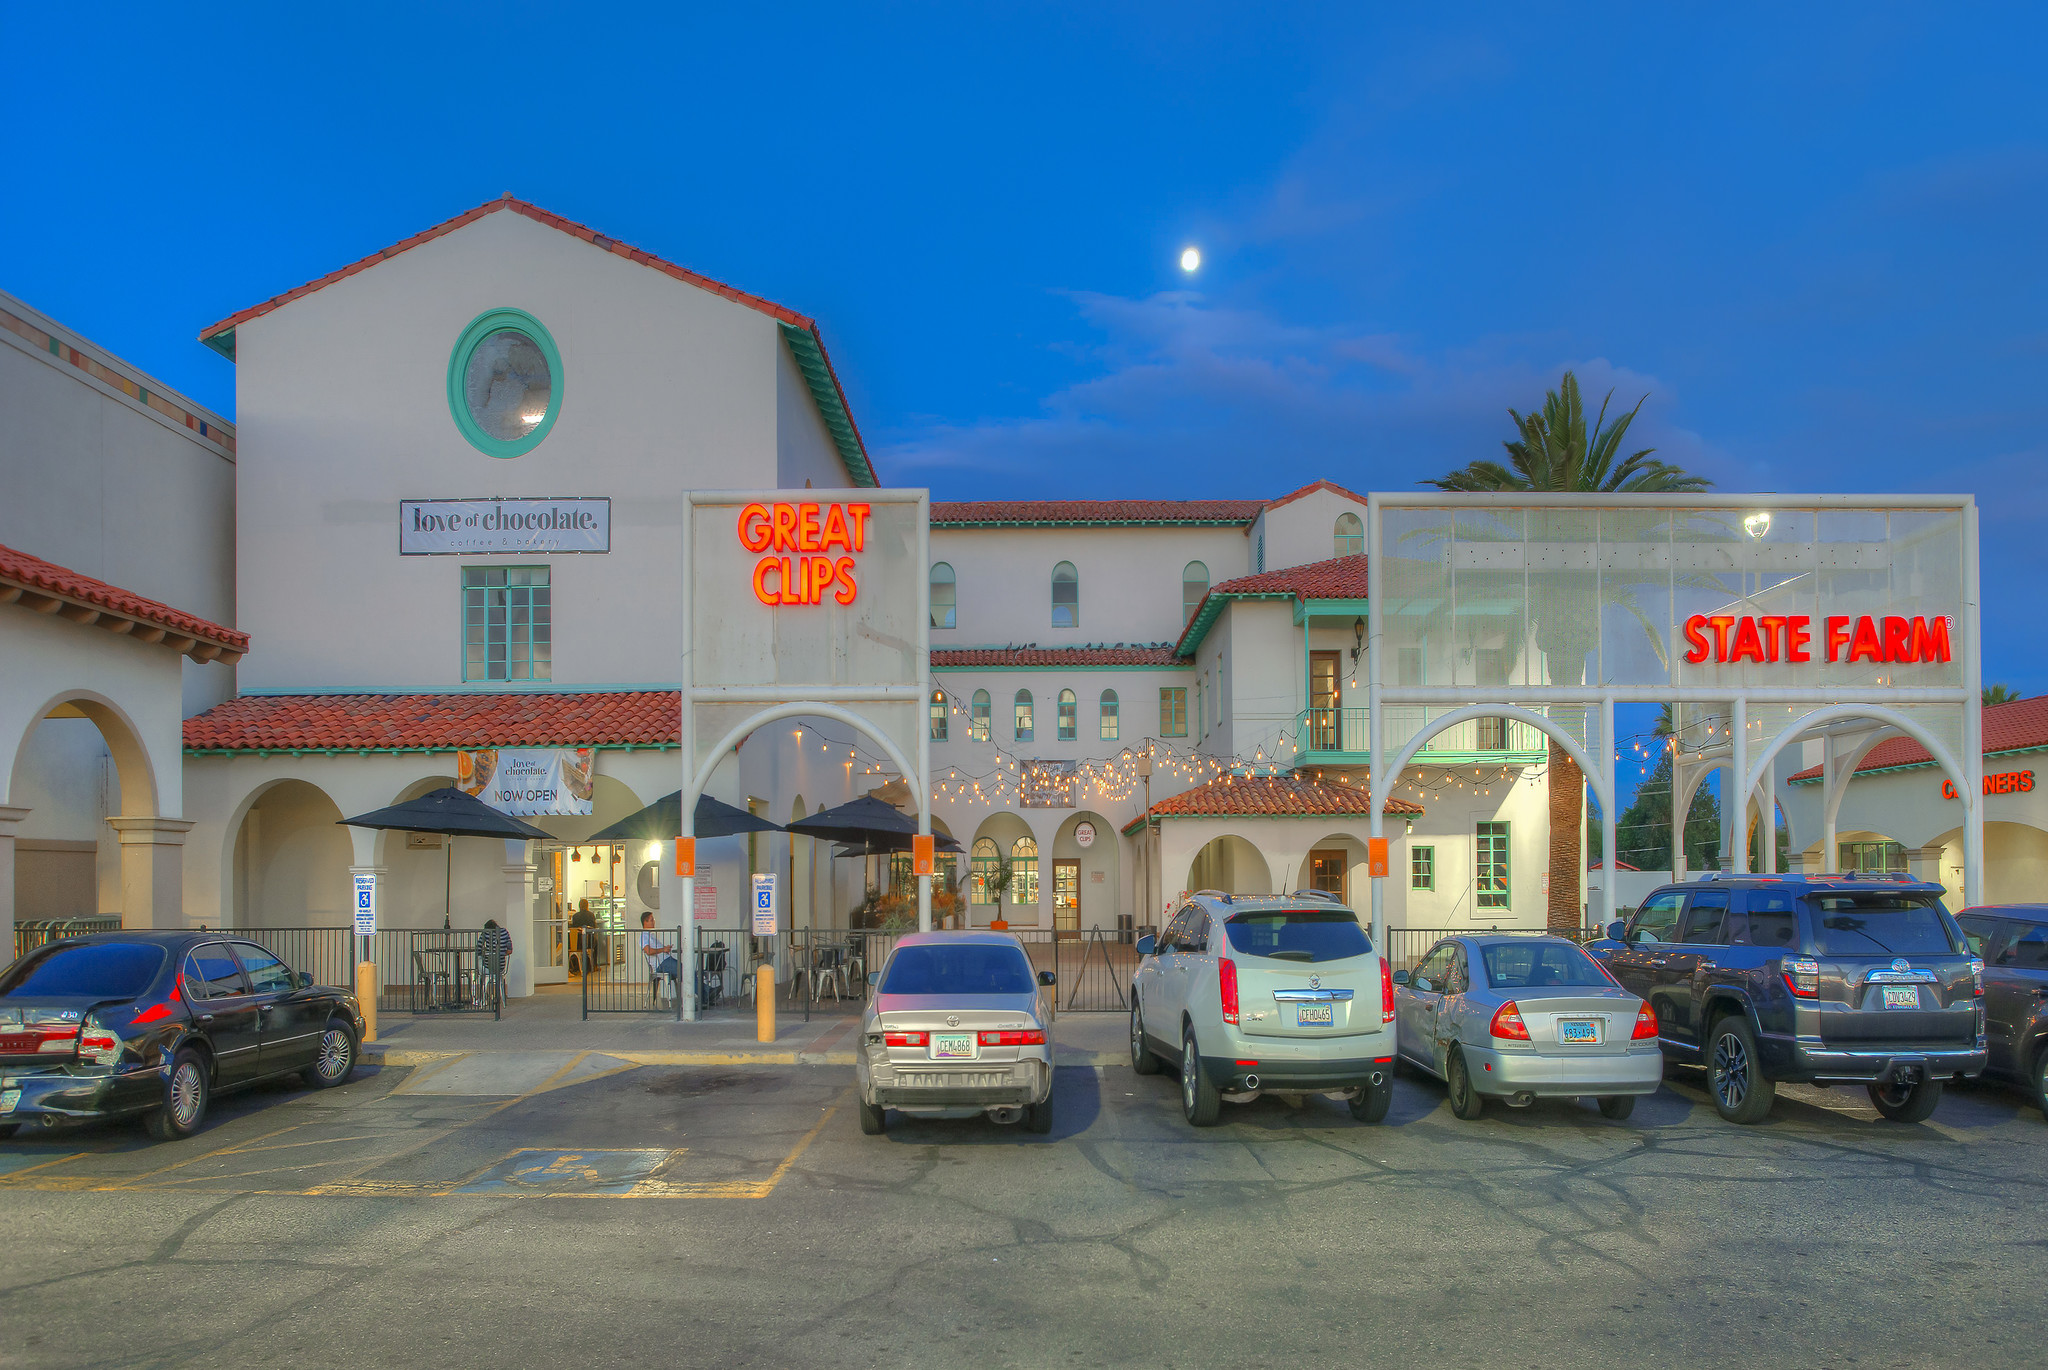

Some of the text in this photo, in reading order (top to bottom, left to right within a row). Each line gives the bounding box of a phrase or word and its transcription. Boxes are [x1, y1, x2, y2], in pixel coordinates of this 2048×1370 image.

[413, 506, 597, 532] love of chocolate.
[738, 503, 871, 553] GREAT
[451, 536, 560, 548] coffee & bakery
[753, 556, 857, 606] CLIPS
[1682, 614, 1951, 664] STATE FARM
[513, 759, 531, 768] love
[495, 789, 558, 802] NOW OPEN
